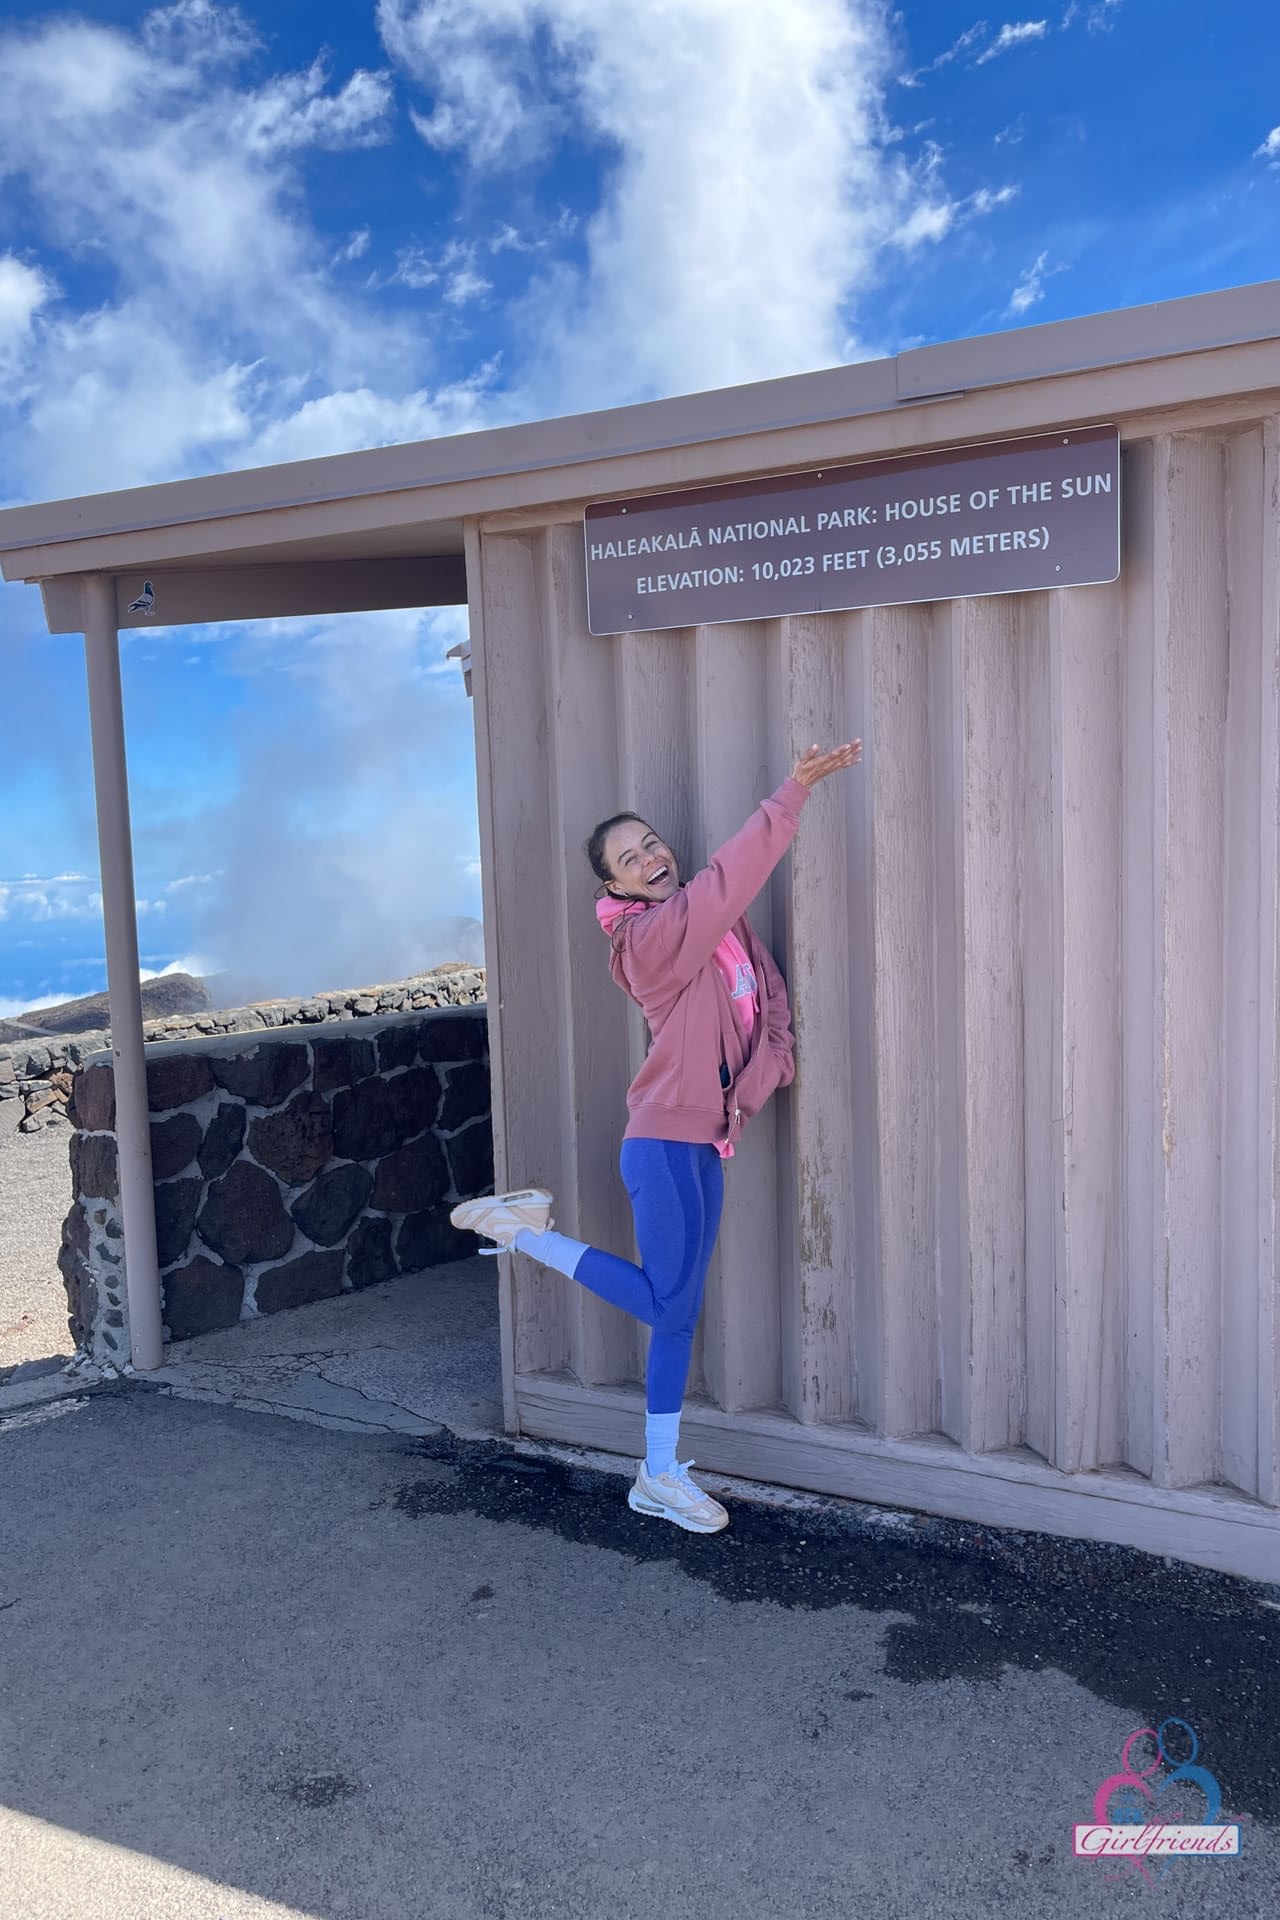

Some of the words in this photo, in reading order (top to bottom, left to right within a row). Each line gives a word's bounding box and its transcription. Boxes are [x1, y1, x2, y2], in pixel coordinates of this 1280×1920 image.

[591, 527, 702, 560] HALEAKALĀ
[708, 515, 810, 545] NATIONAL
[817, 506, 877, 531] PARK:
[886, 494, 961, 521] HOUSE
[969, 488, 999, 510] OF
[1007, 481, 1052, 505] THE
[1061, 473, 1112, 498] SUN
[637, 566, 744, 594] ELEVATION:
[752, 556, 815, 581] 10,023
[823, 549, 870, 572] FEET
[876, 540, 942, 569] (3,055
[950, 526, 1050, 557] METERS)
